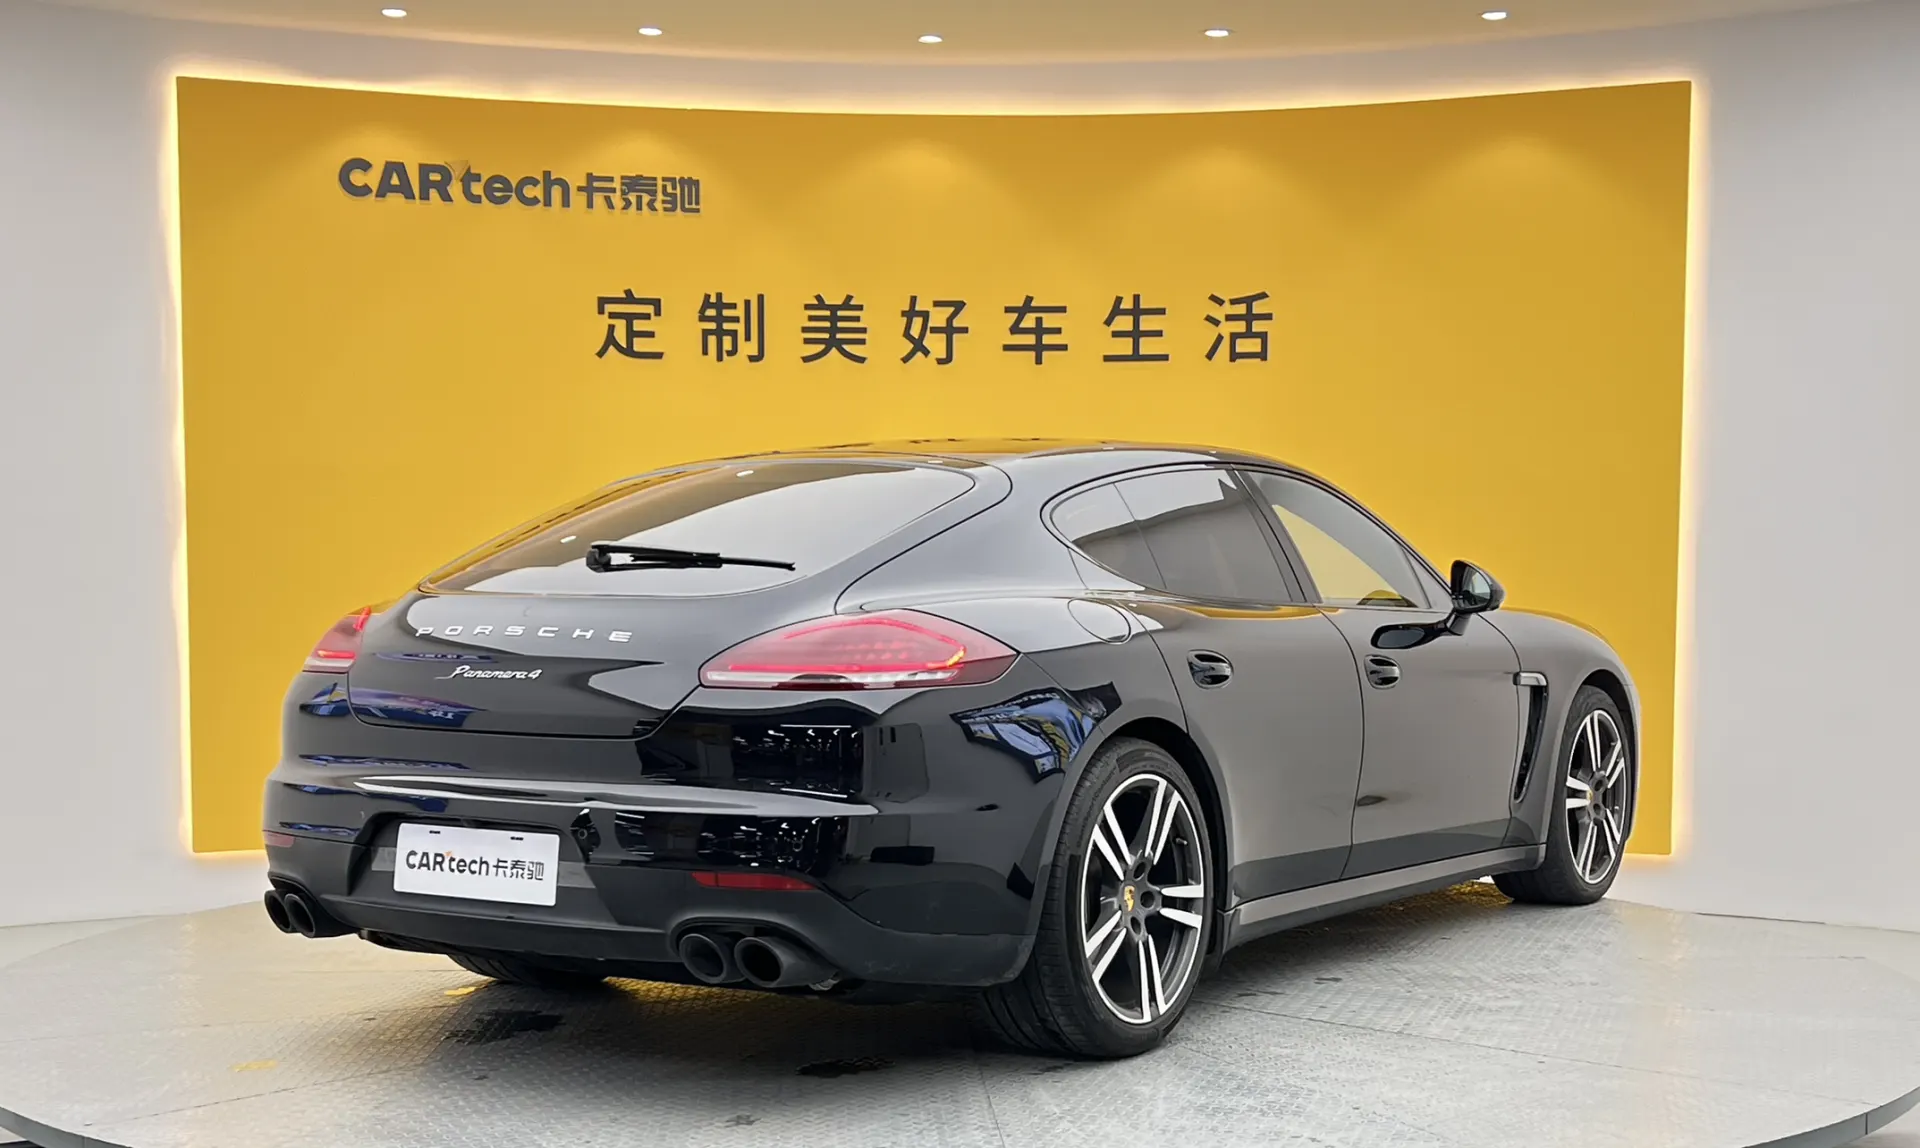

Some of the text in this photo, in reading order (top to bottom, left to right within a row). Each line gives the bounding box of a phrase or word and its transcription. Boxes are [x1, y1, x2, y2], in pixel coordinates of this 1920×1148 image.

[338, 157, 700, 214] CARtech 卡泰驰
[595, 289, 1274, 365] 定制美好车生活
[415, 626, 632, 643] PORSCHE
[406, 850, 544, 881] CARtech 卡泰驰
